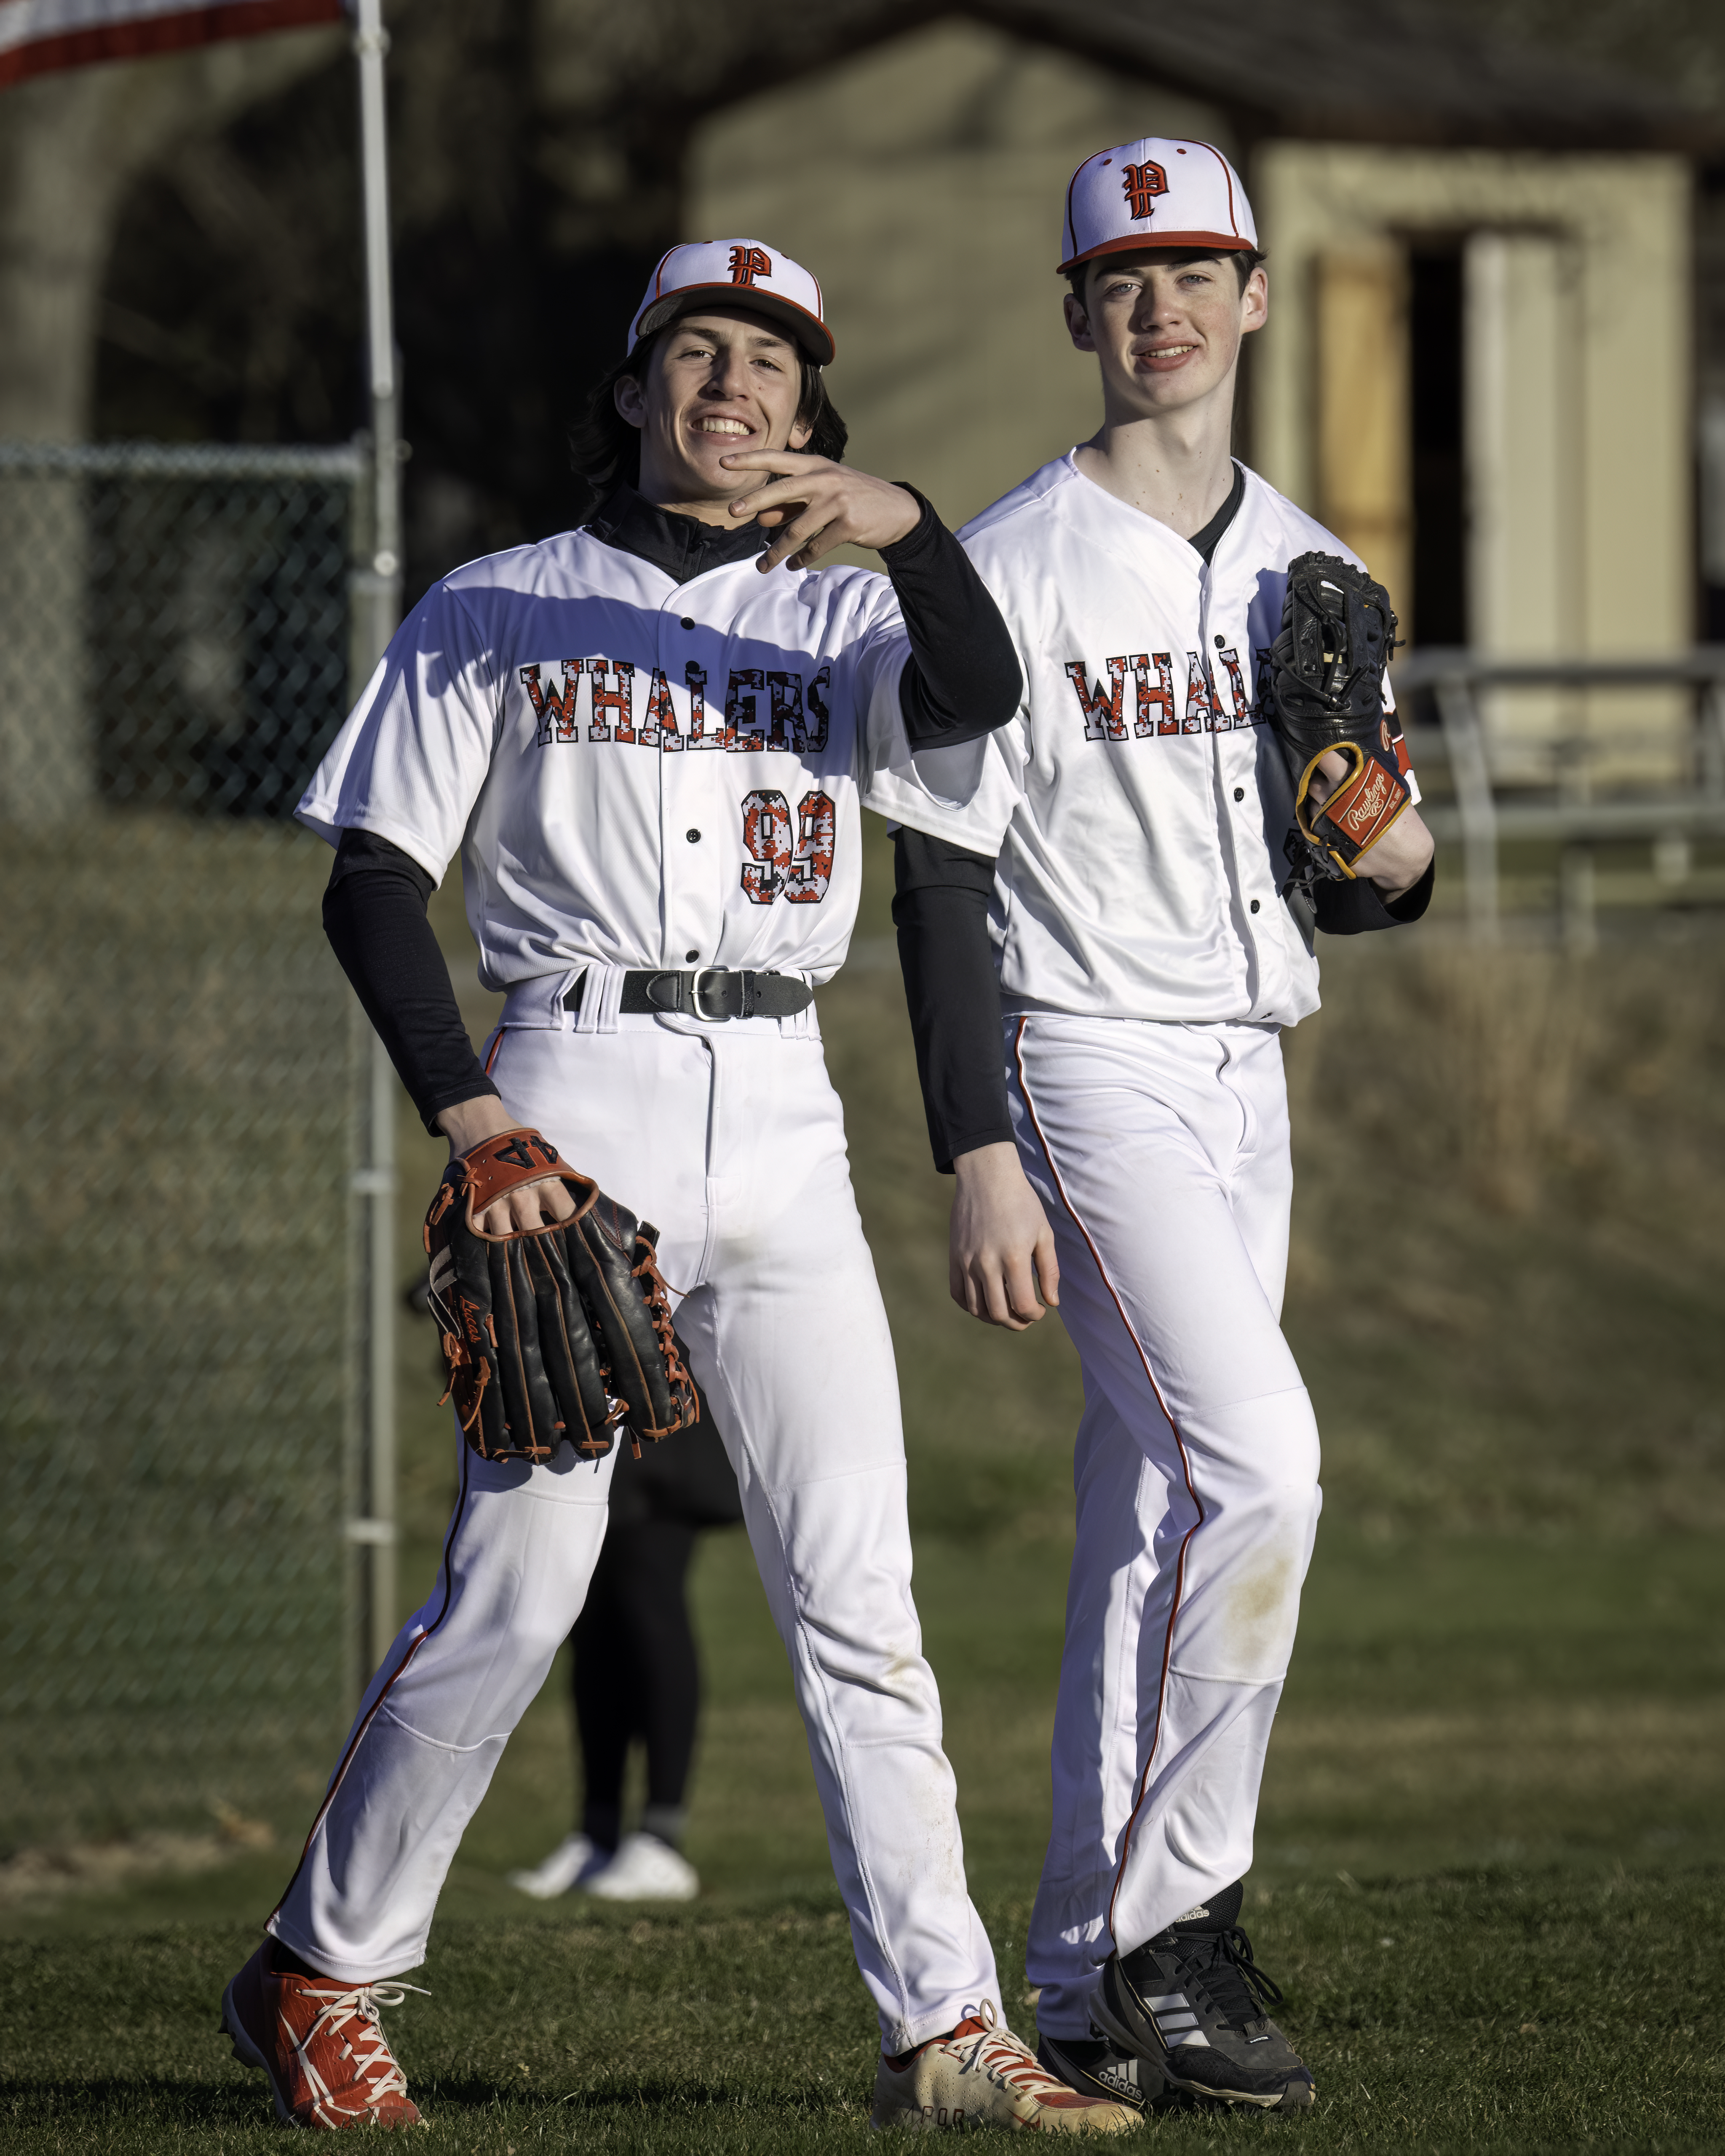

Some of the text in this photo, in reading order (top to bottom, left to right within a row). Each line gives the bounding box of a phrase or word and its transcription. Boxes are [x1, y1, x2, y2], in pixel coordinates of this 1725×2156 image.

[1121, 160, 1170, 220] P
[728, 246, 772, 287] P
[519, 658, 831, 753] WHALERS
[1347, 773, 1387, 831] Rawlings
[740, 789, 836, 905] 99
[1098, 2071, 1143, 2100] adidas
